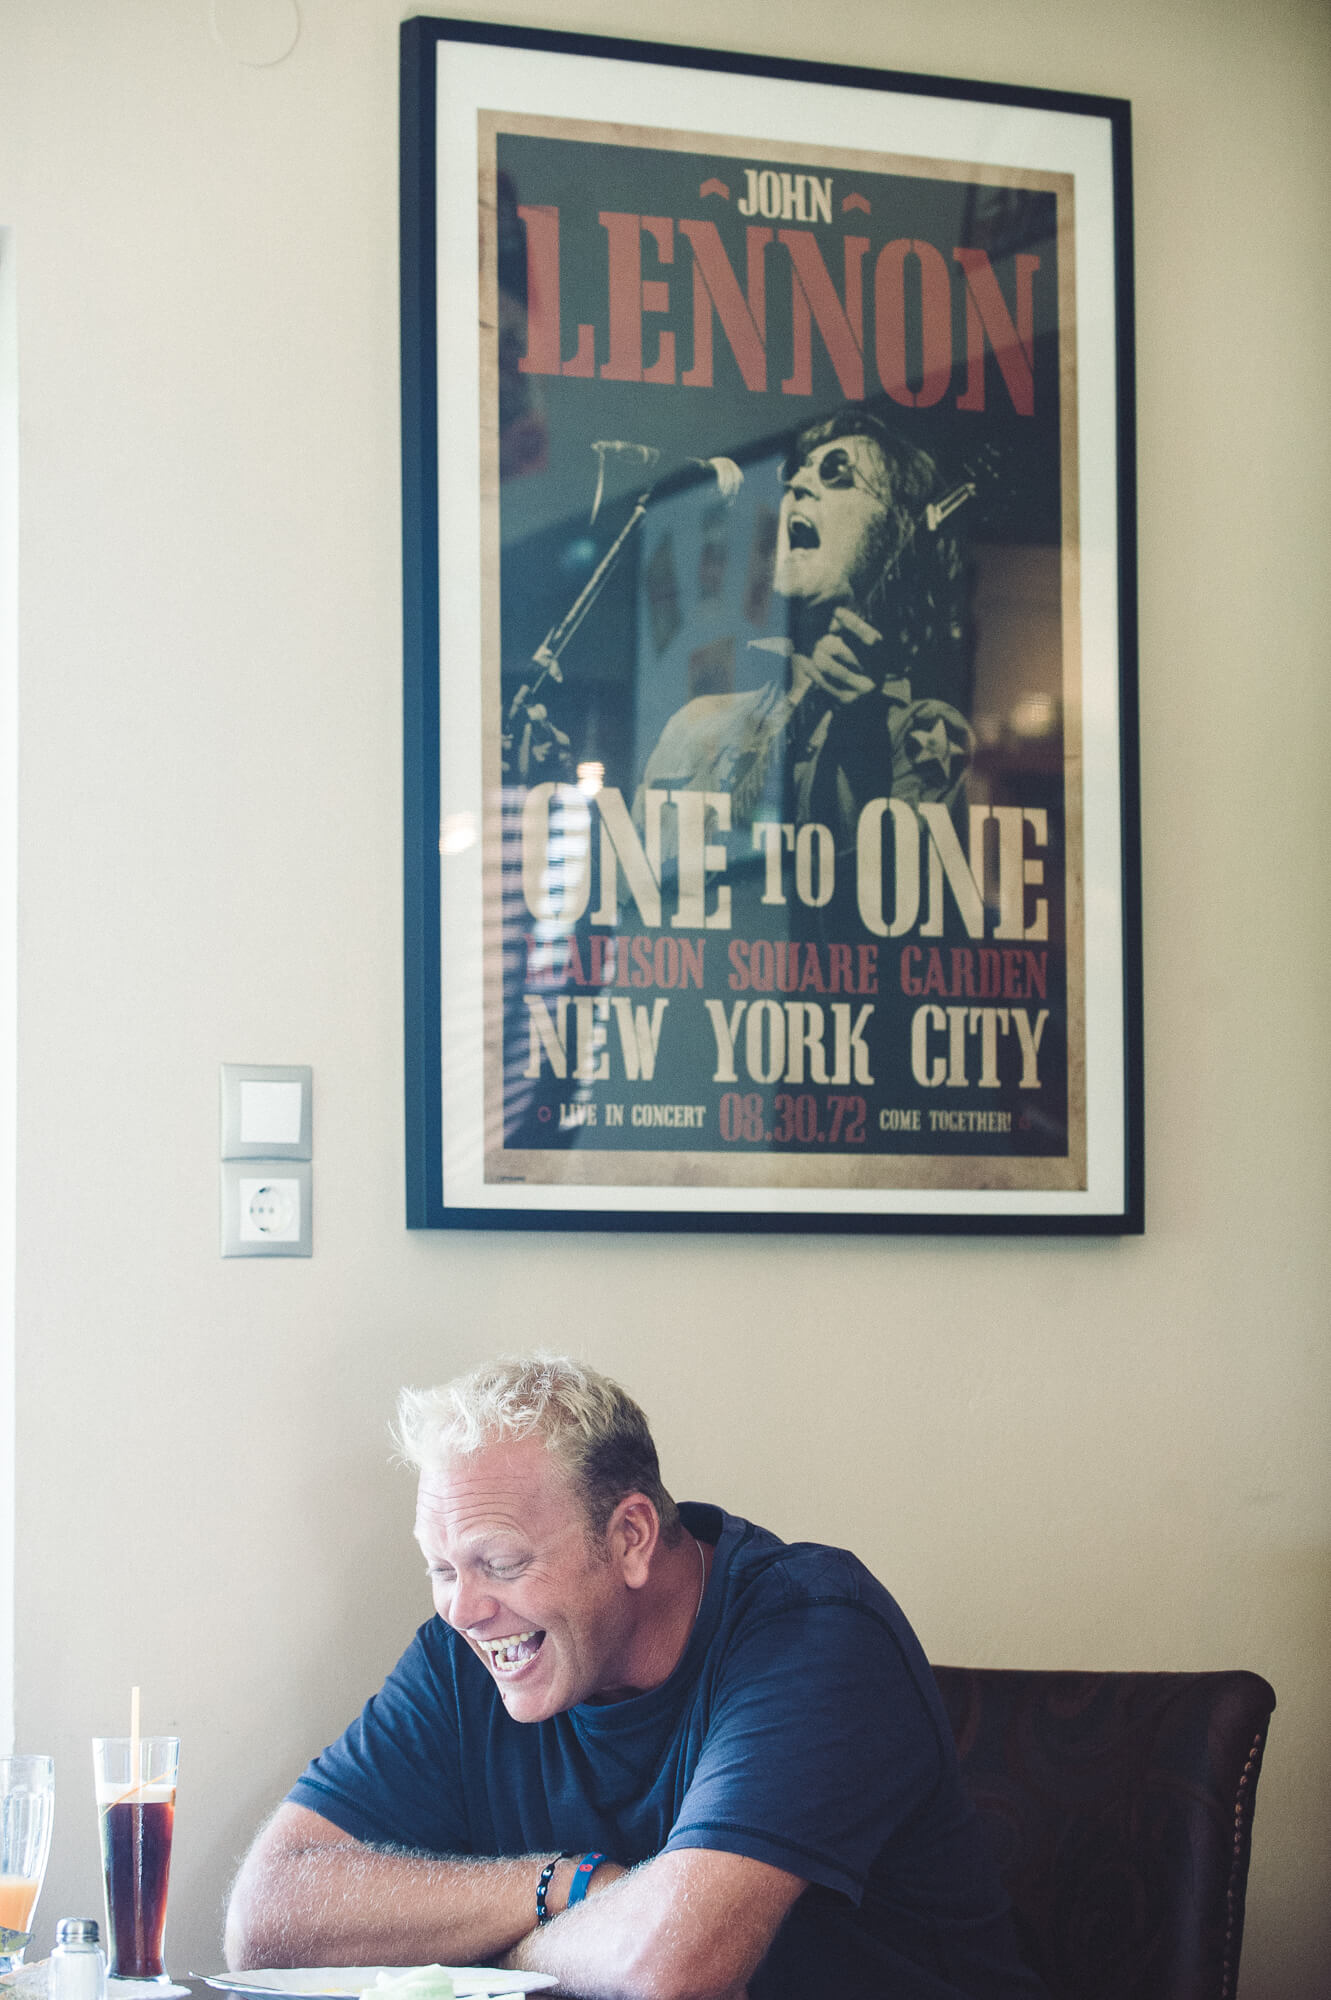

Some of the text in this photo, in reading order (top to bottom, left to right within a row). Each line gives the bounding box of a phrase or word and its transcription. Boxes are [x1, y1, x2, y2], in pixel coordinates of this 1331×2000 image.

[738, 169, 833, 223] JOHN
[517, 204, 1041, 417] LENNON
[522, 782, 1048, 941] ONE TO ONE
[728, 939, 879, 995] SQUARE
[900, 945, 1048, 1000] GARDEN
[523, 994, 1049, 1089] NEW YORK CITY
[559, 1104, 706, 1129] LIVE IN CONCERT
[718, 1092, 867, 1144] 08.30.72
[879, 1108, 924, 1132] COME
